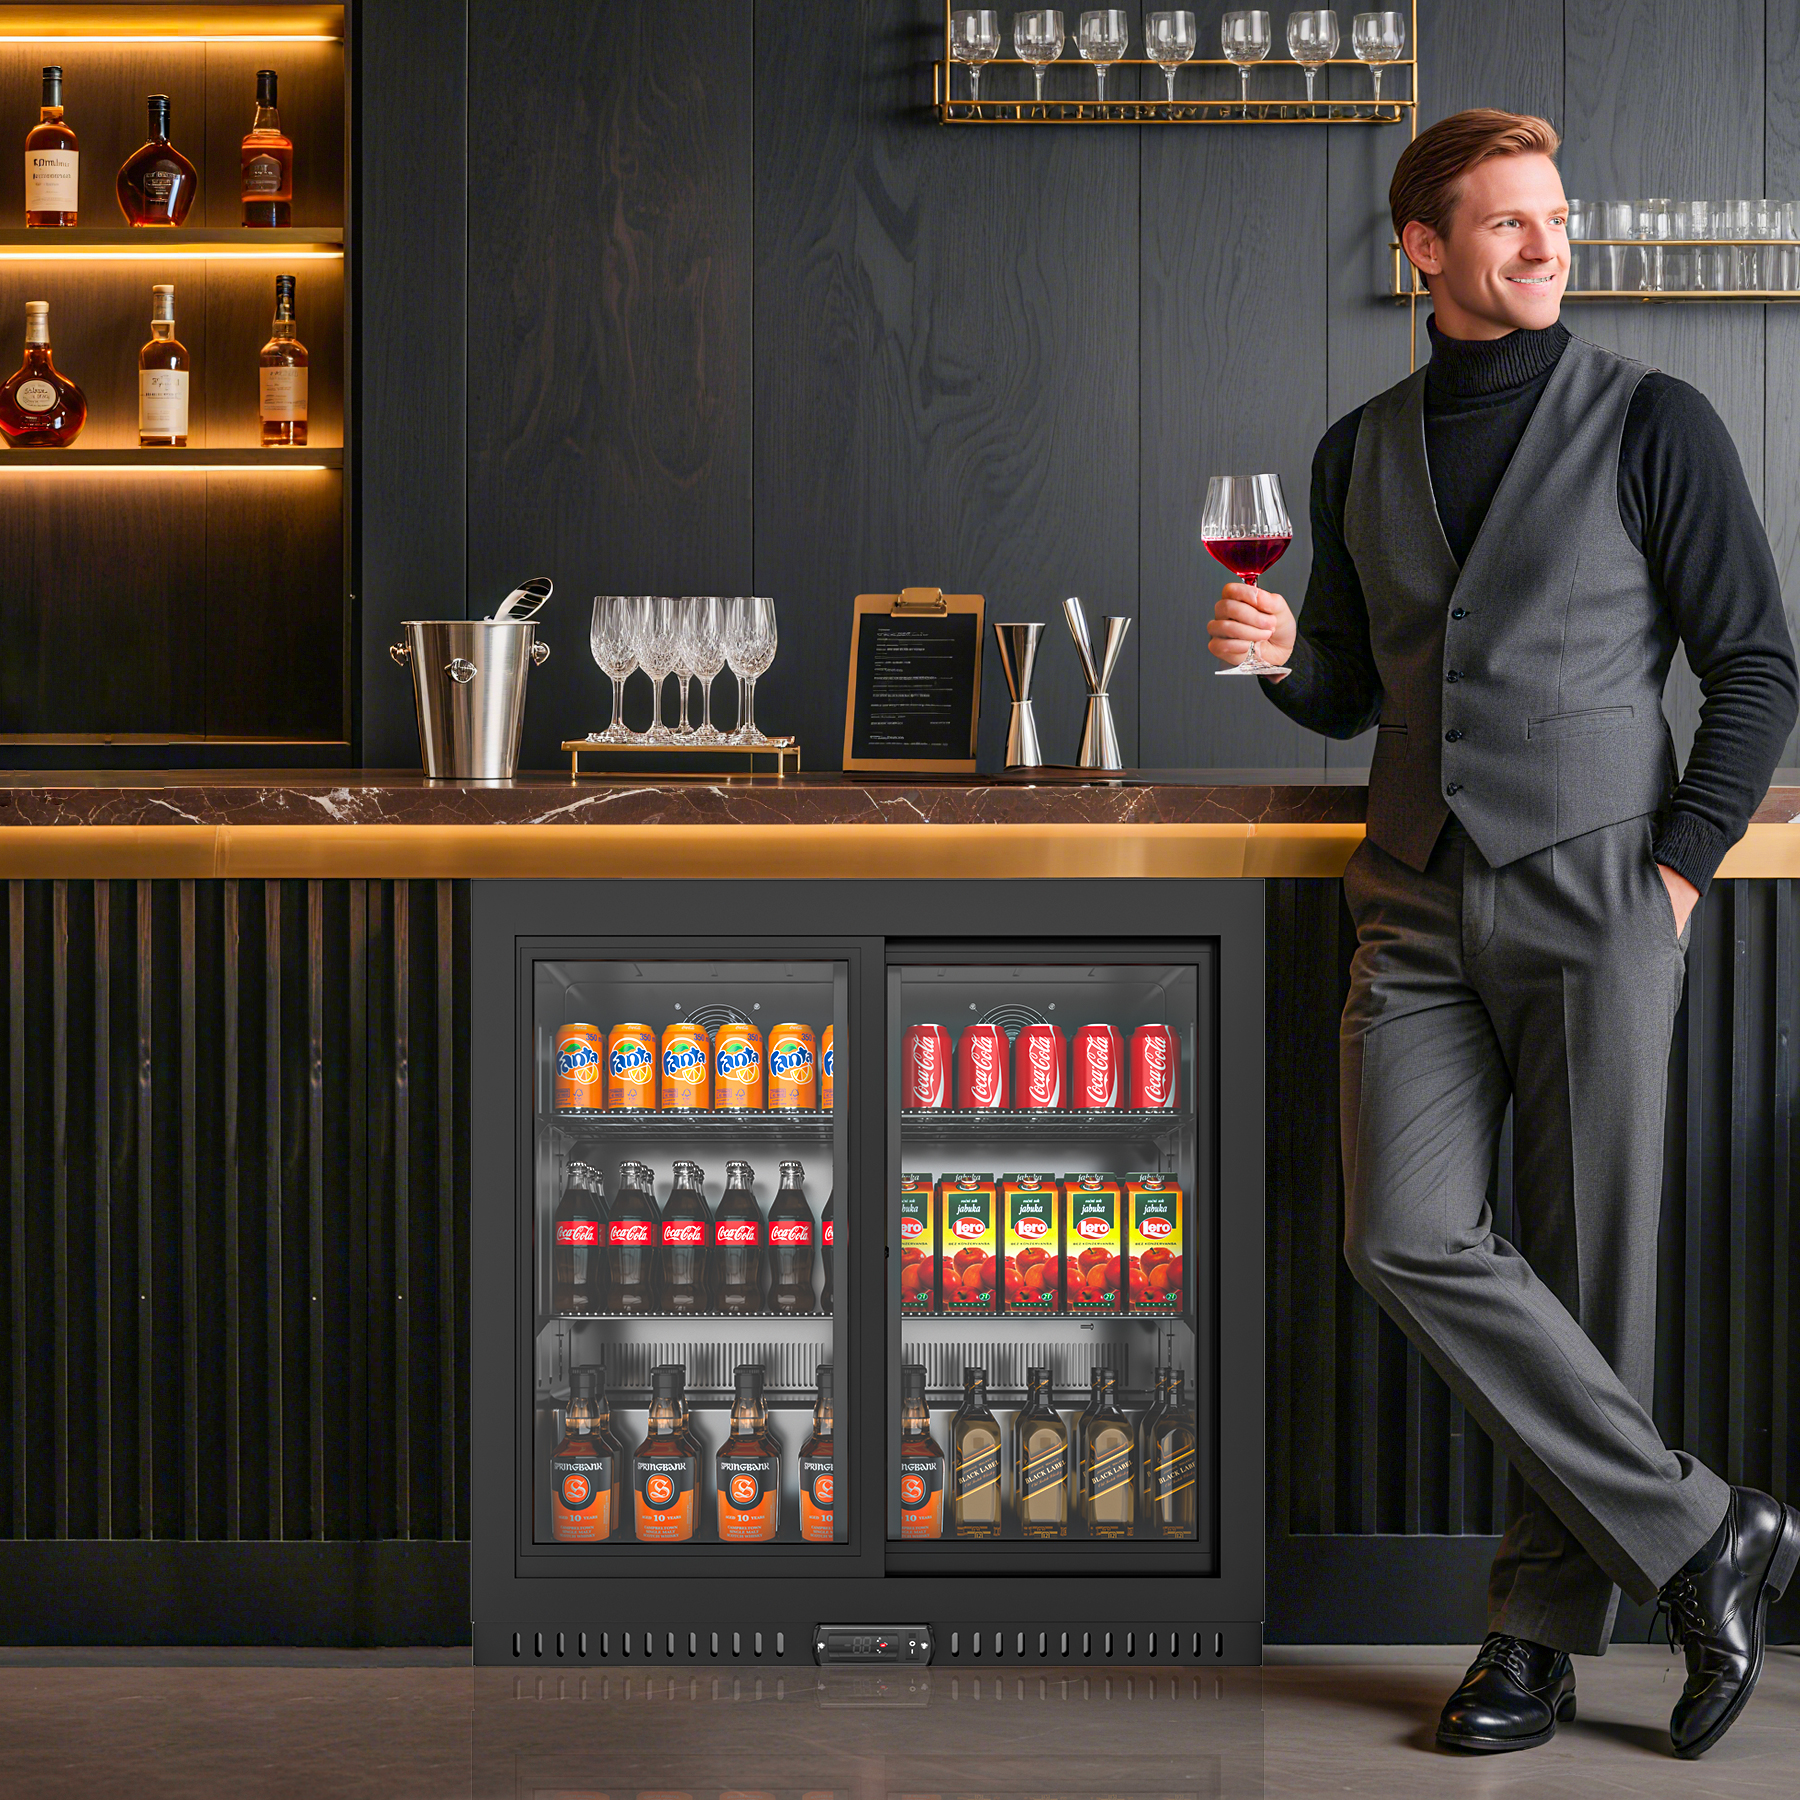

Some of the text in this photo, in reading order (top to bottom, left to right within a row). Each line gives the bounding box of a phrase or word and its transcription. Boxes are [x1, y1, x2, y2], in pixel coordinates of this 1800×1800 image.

[556, 1046, 599, 1076] Fanta
[608, 1046, 652, 1076] Fanta
[662, 1046, 706, 1076] Fanta
[716, 1046, 760, 1076] Fanta
[770, 1046, 813, 1076] Fanta
[902, 1204, 918, 1213] buka
[956, 1204, 980, 1215] jabuka
[1018, 1204, 1043, 1215] jabuka
[1081, 1204, 1106, 1215] jabuka
[1143, 1204, 1168, 1215] jabuka
[557, 1226, 594, 1241] Coca-Cola
[610, 1226, 648, 1241] Coca-Cola
[664, 1226, 702, 1241] Coca-Cola
[718, 1226, 756, 1241] Coca-Cola
[771, 1226, 808, 1241] Coca-Cola
[902, 1224, 922, 1233] ero
[956, 1221, 984, 1235] Lero
[1018, 1221, 1046, 1235] Lero
[1080, 1221, 1108, 1235] Lero
[1143, 1221, 1171, 1235] Lero
[804, 1462, 833, 1471] SPRING
[902, 1462, 937, 1471] NGBANK
[958, 1470, 980, 1484] BLACK
[980, 1460, 999, 1474] LABEL
[1025, 1470, 1046, 1484] BLACK
[1047, 1460, 1066, 1474] LABEL
[1092, 1470, 1113, 1484] BLACK
[1114, 1460, 1132, 1474] LABEL
[1158, 1470, 1180, 1484] BLACK
